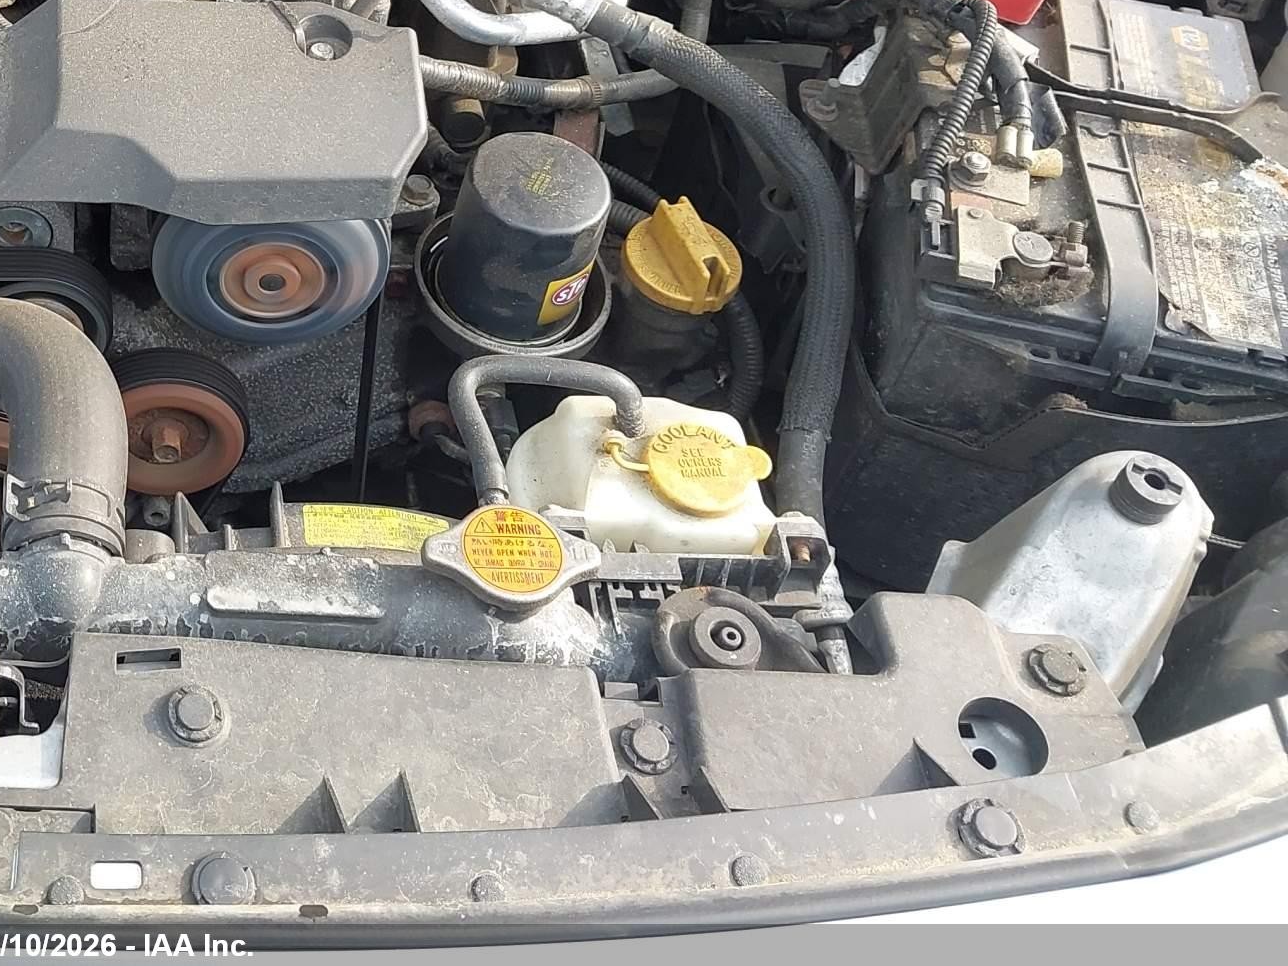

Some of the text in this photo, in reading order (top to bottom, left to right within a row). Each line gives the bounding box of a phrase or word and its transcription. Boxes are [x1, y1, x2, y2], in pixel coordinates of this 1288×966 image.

[652, 424, 736, 453] COOLANT
[681, 448, 704, 458] SEE
[680, 467, 727, 479] MANUAL
[495, 523, 542, 535] WARNING
[471, 548, 494, 557] NEVER
[496, 548, 515, 557] OPEN
[517, 549, 537, 558] WHEN
